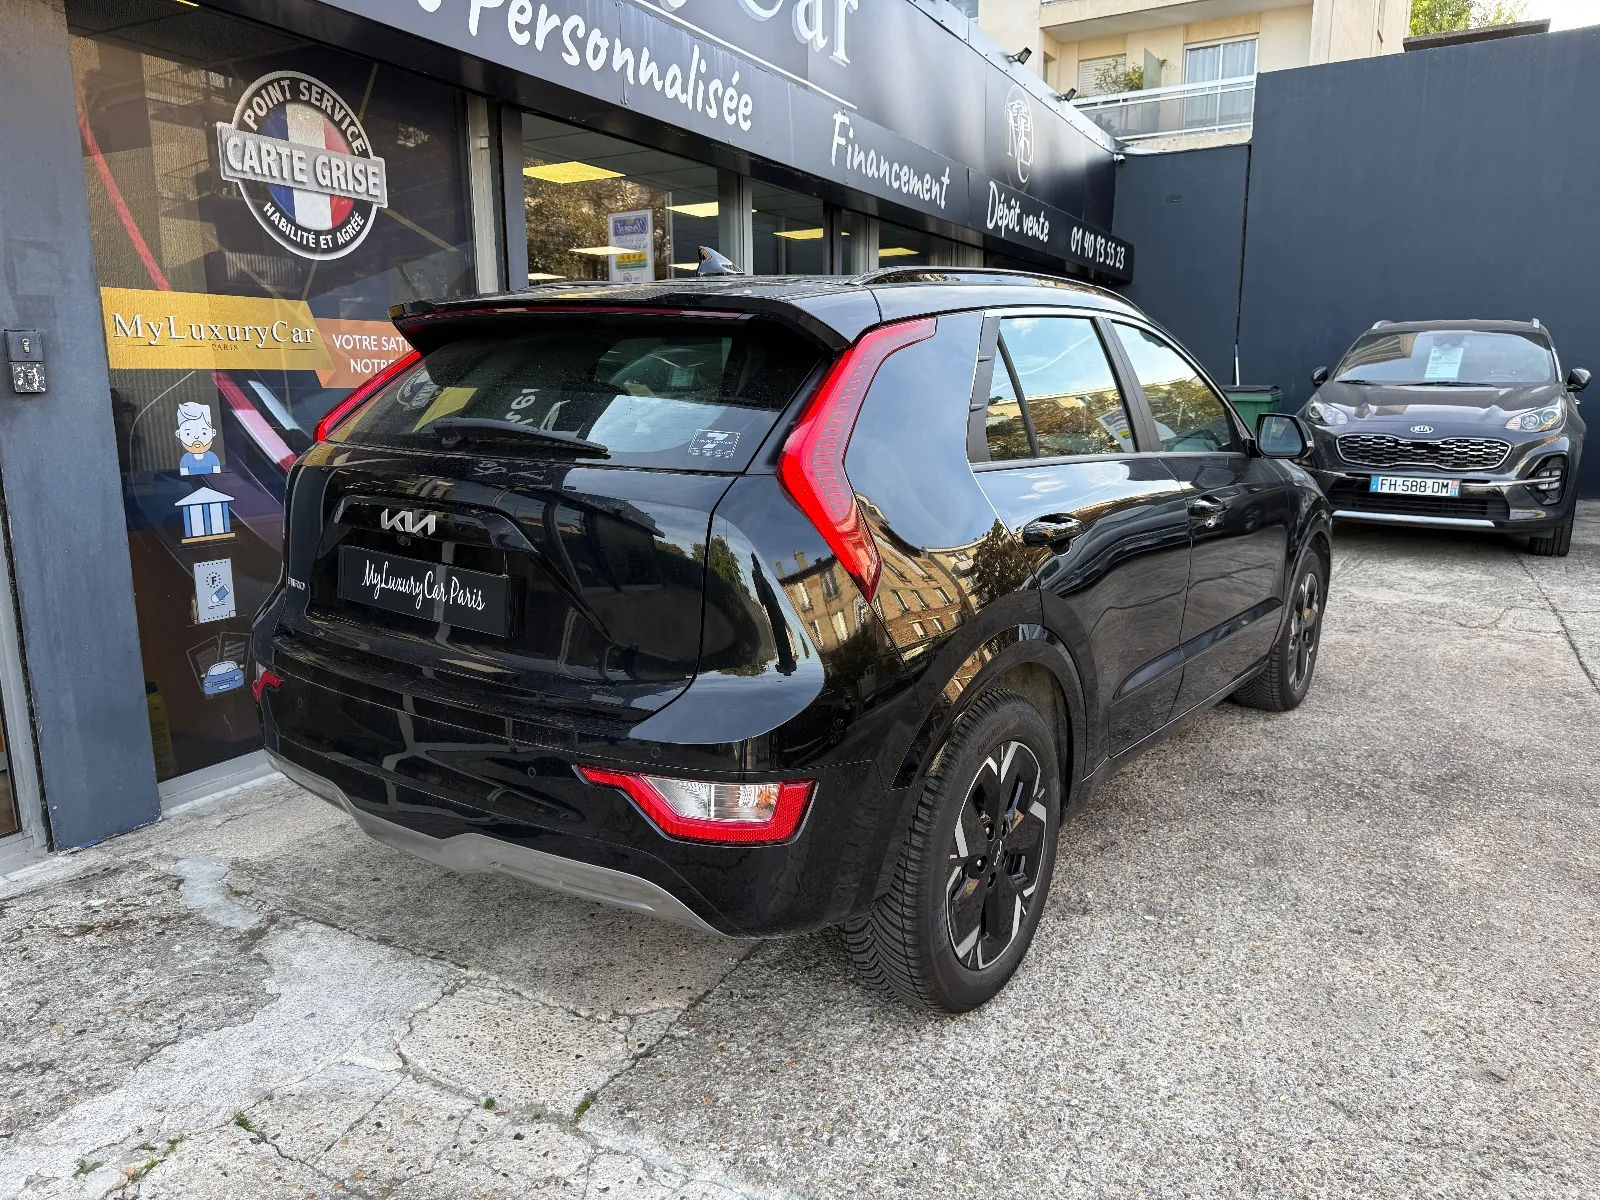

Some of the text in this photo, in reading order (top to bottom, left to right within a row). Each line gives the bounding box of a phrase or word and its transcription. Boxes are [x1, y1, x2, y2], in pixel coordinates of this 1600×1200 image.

[243, 79, 366, 156] POINT SERVICE
[226, 136, 381, 197] CARTE GRISE
[831, 110, 950, 209] Financement
[263, 202, 365, 249] HABILITÉ ET AGRÉÉ
[986, 180, 1049, 242] Dépôt vente
[1070, 226, 1125, 270] 01 40 93 55 23
[111, 313, 315, 349] MyLuxuryCar
[211, 343, 239, 351] PARIS
[332, 333, 378, 351] VOTRE
[361, 559, 485, 611] MyLuxuryCar Paris
